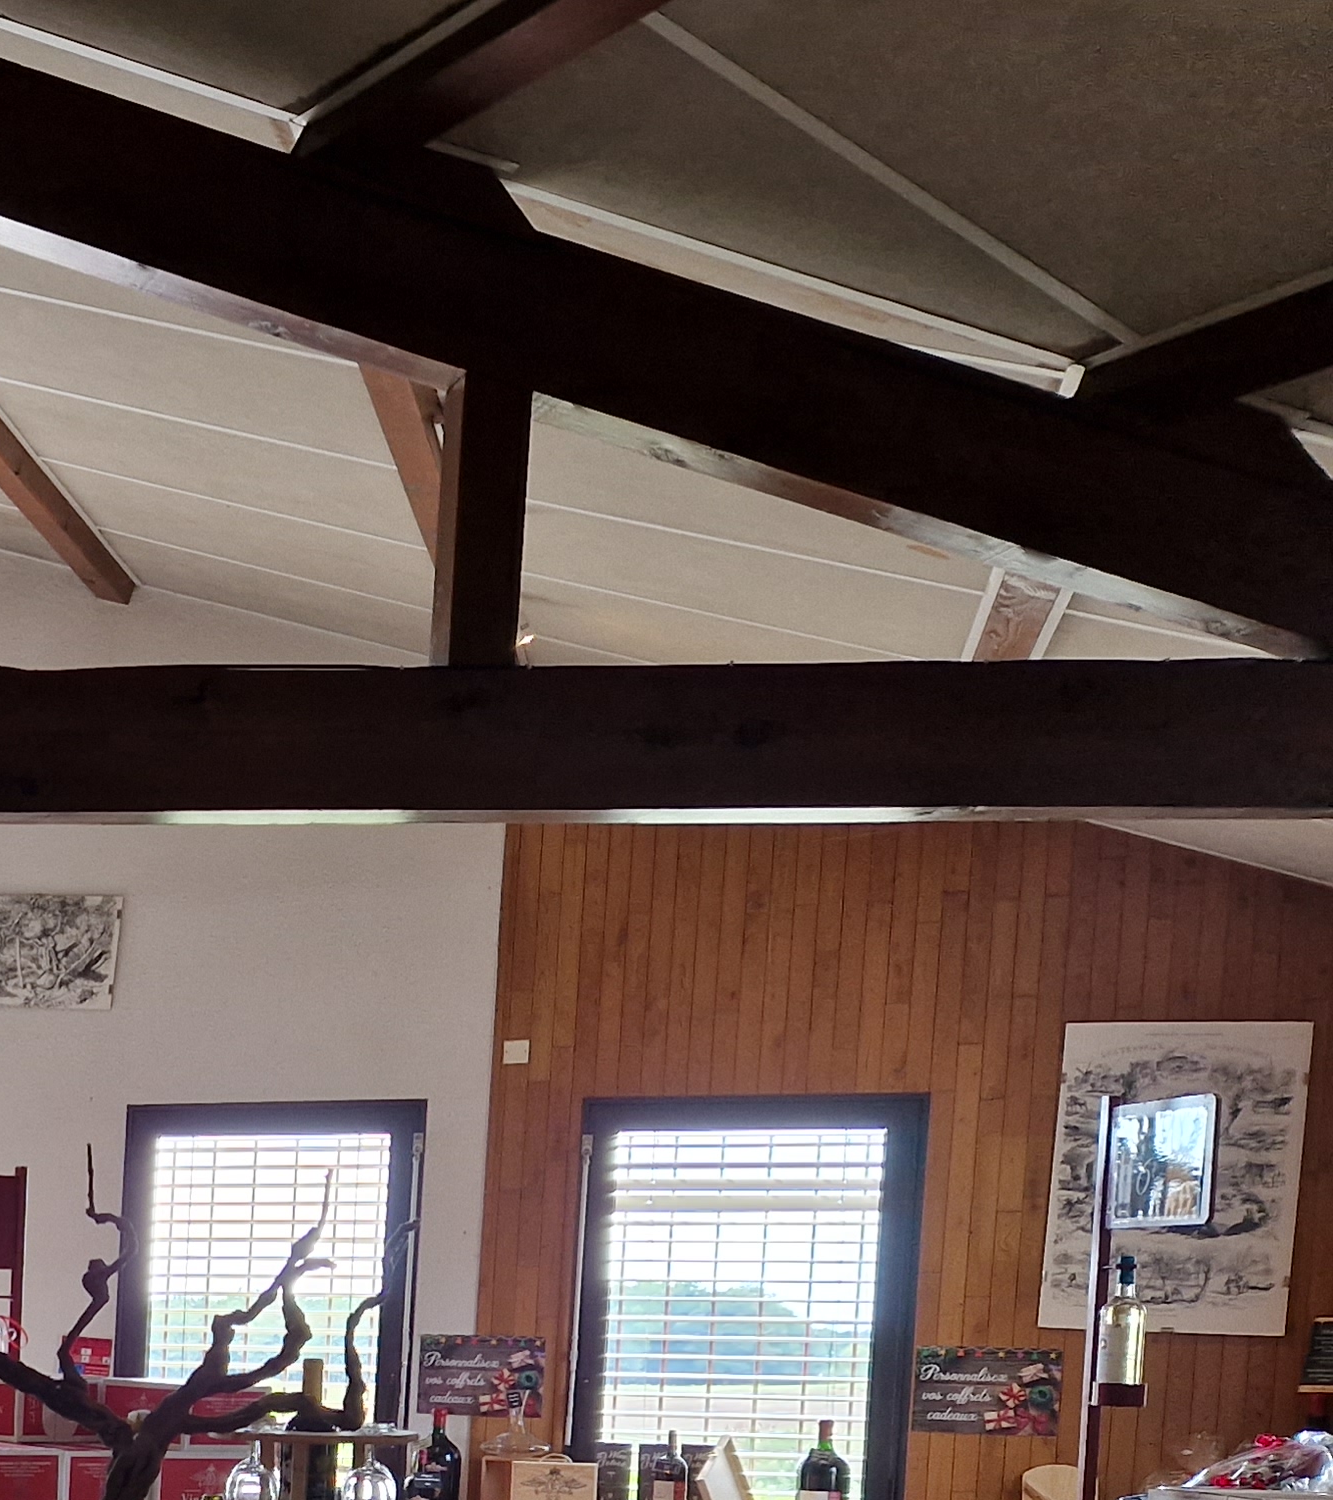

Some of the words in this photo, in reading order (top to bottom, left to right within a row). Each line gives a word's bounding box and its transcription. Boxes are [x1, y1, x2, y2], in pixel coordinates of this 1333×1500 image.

[423, 1351, 501, 1369] Personnalisez
[425, 1377, 443, 1385] vos
[446, 1371, 487, 1389] coffrets
[919, 1363, 1009, 1383] Personnalisez
[429, 1390, 475, 1405] cadeaux
[921, 1392, 943, 1401] vos
[946, 1386, 992, 1405] coffrets
[926, 1406, 978, 1422] cadeaux
